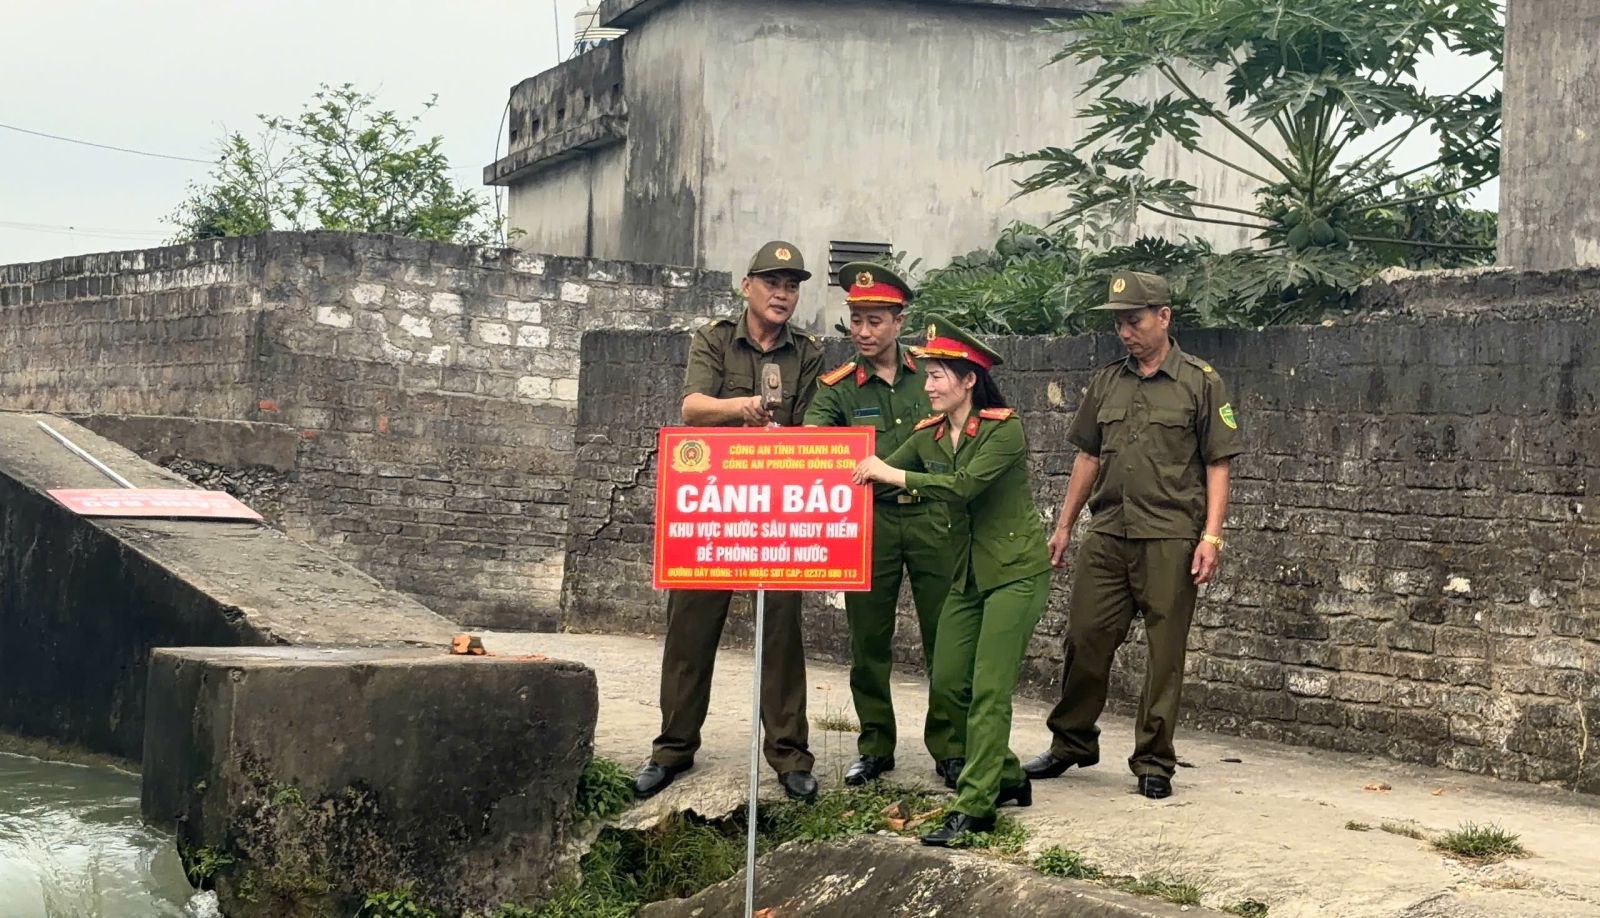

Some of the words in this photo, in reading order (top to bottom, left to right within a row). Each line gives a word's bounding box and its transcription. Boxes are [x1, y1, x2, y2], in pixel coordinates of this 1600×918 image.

[730, 443, 755, 455] CÔNG
[757, 444, 771, 455] AN
[799, 444, 828, 455] THANH
[831, 442, 850, 455] HÓA
[722, 458, 748, 469] CÔNG
[751, 459, 764, 469] AN
[767, 457, 805, 469] PHƯỜNG
[808, 457, 833, 469] ĐÔNG
[836, 458, 856, 469] SƠN
[676, 475, 771, 513] CẢNH
[782, 478, 852, 513] BÁO
[669, 522, 694, 538] KHU
[697, 520, 721, 541] VỰC
[724, 519, 758, 538] NƯỚC
[761, 519, 786, 538] SÂU
[789, 522, 823, 538] NGUY
[826, 516, 858, 538] HIỂM
[716, 542, 758, 562] PHÒNG
[761, 541, 791, 562] ĐUỐI
[794, 544, 828, 563] NƯỚC
[735, 568, 747, 577] 114
